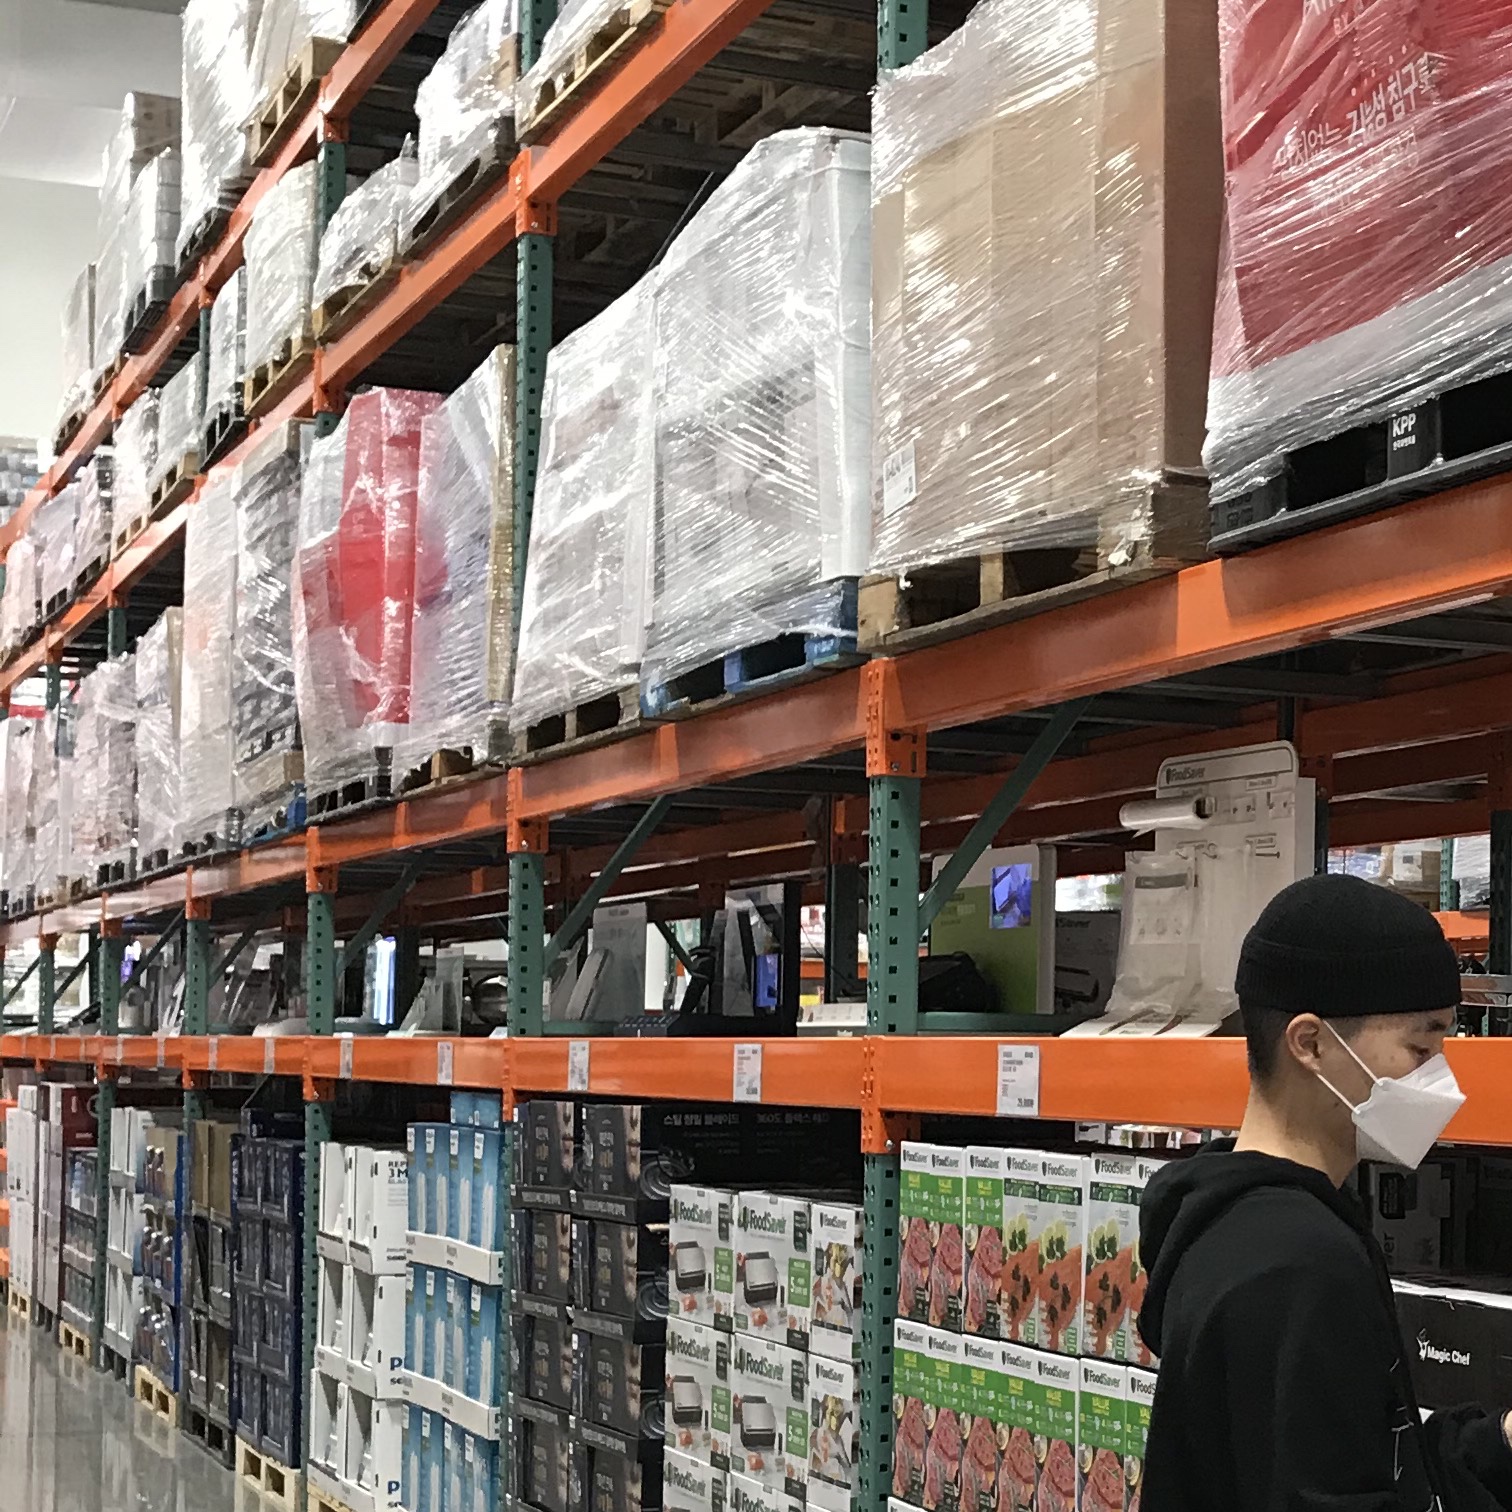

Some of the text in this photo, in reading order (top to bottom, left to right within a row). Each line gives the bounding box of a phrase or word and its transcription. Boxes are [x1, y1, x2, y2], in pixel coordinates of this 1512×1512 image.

[1392, 412, 1416, 435] KPP
[1170, 767, 1205, 782] FoodSaver
[1011, 1158, 1039, 1172] FoodSaver
[1048, 1160, 1078, 1178] FoodSaver
[1101, 1159, 1132, 1176] FoodSaver
[680, 1202, 712, 1224] FoodSaver
[751, 1210, 786, 1233] FoodSaver
[1006, 1352, 1032, 1371] FoodSaver
[1426, 1345, 1471, 1366] Magic Chef
[747, 1353, 784, 1381] FoodSaver
[1042, 1362, 1071, 1381] FoodSaver
[1089, 1370, 1121, 1390] FoodSaver
[1136, 1377, 1156, 1395] FoodS
